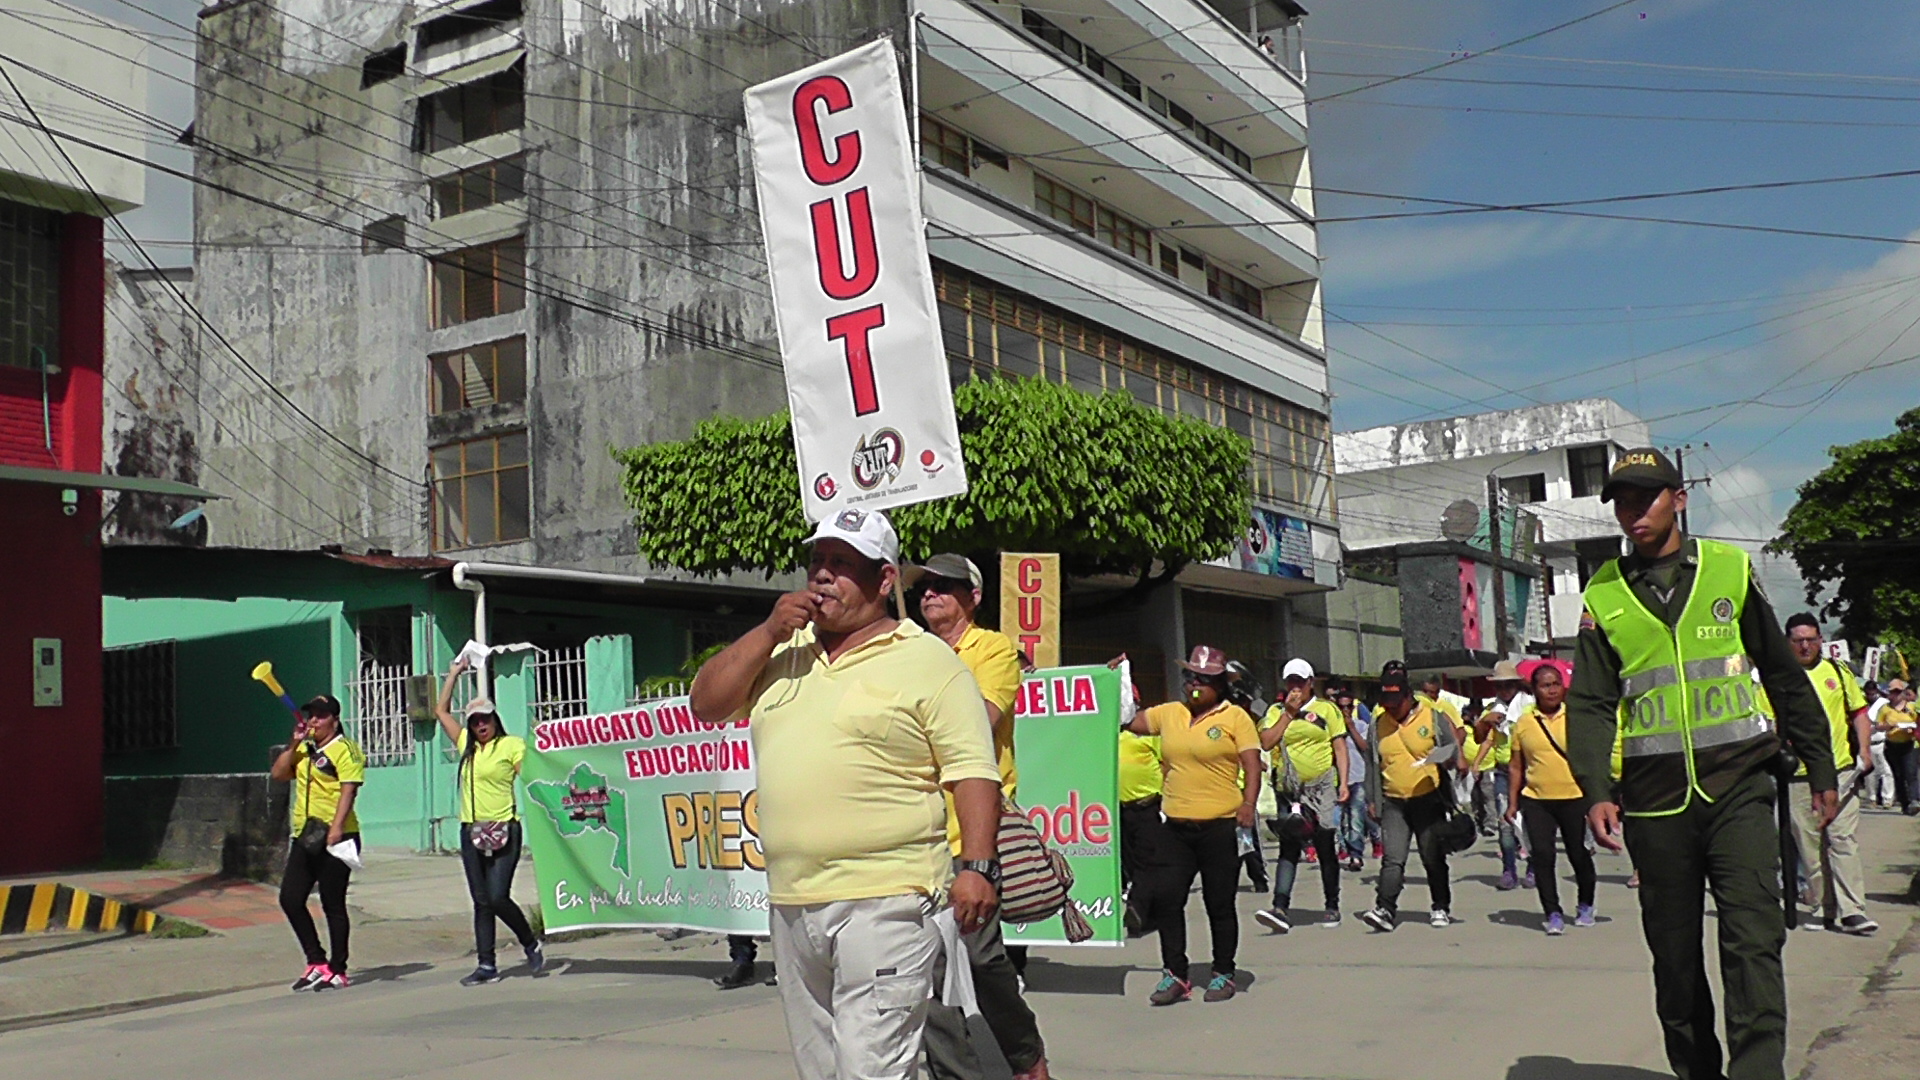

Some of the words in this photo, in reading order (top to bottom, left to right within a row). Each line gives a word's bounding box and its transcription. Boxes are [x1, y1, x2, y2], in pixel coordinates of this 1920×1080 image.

[793, 75, 885, 417] CUT
[1018, 558, 1042, 666] CUT
[536, 711, 651, 750] SINDICATO
[656, 703, 727, 736] ÚNI
[1054, 678, 1096, 712] LA
[625, 736, 750, 778] EDUCACIÓN
[662, 790, 768, 872] PRES
[555, 879, 584, 910] En
